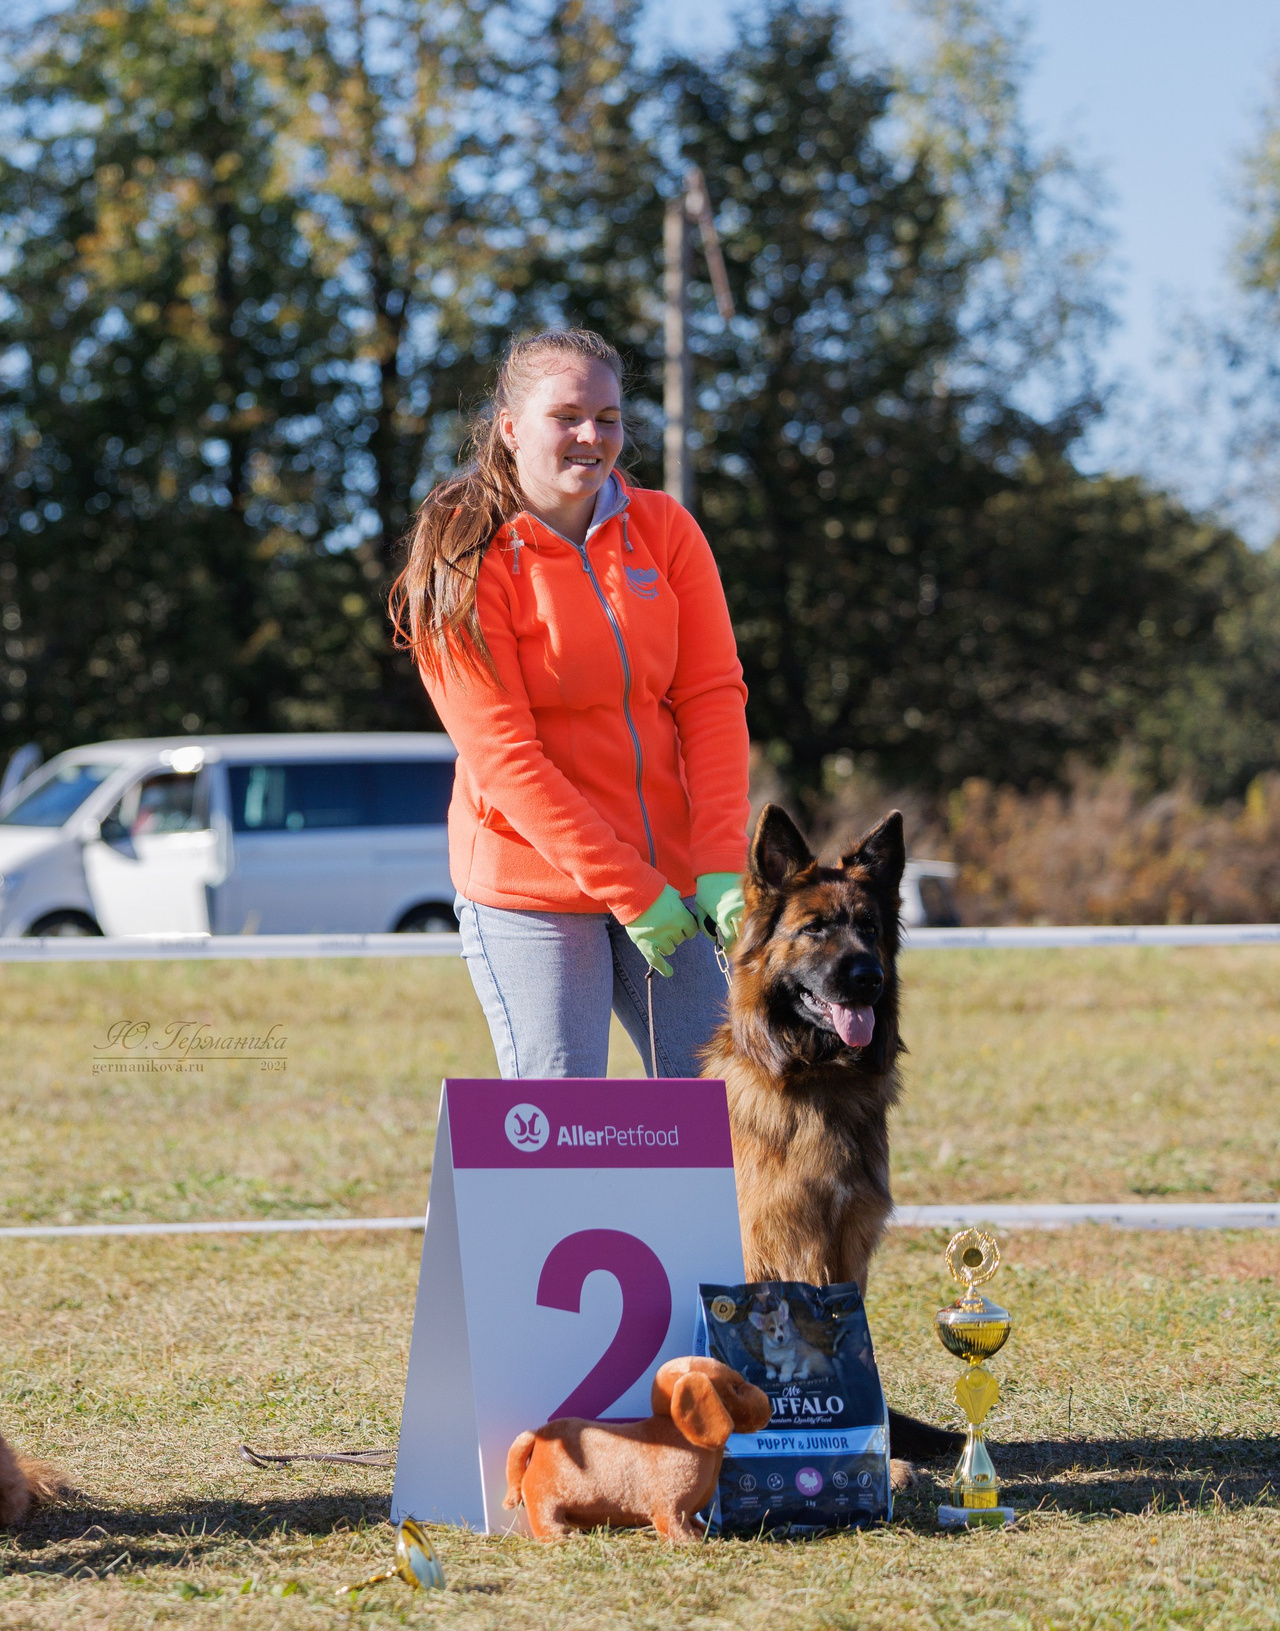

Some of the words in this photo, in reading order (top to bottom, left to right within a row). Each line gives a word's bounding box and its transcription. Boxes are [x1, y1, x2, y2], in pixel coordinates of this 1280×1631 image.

[556, 1124, 679, 1147] AllerPetfood
[536, 1228, 672, 1424] 2
[757, 1437, 795, 1450] PUPPY
[797, 1440, 805, 1449] &
[806, 1436, 849, 1449] JUNIOR
